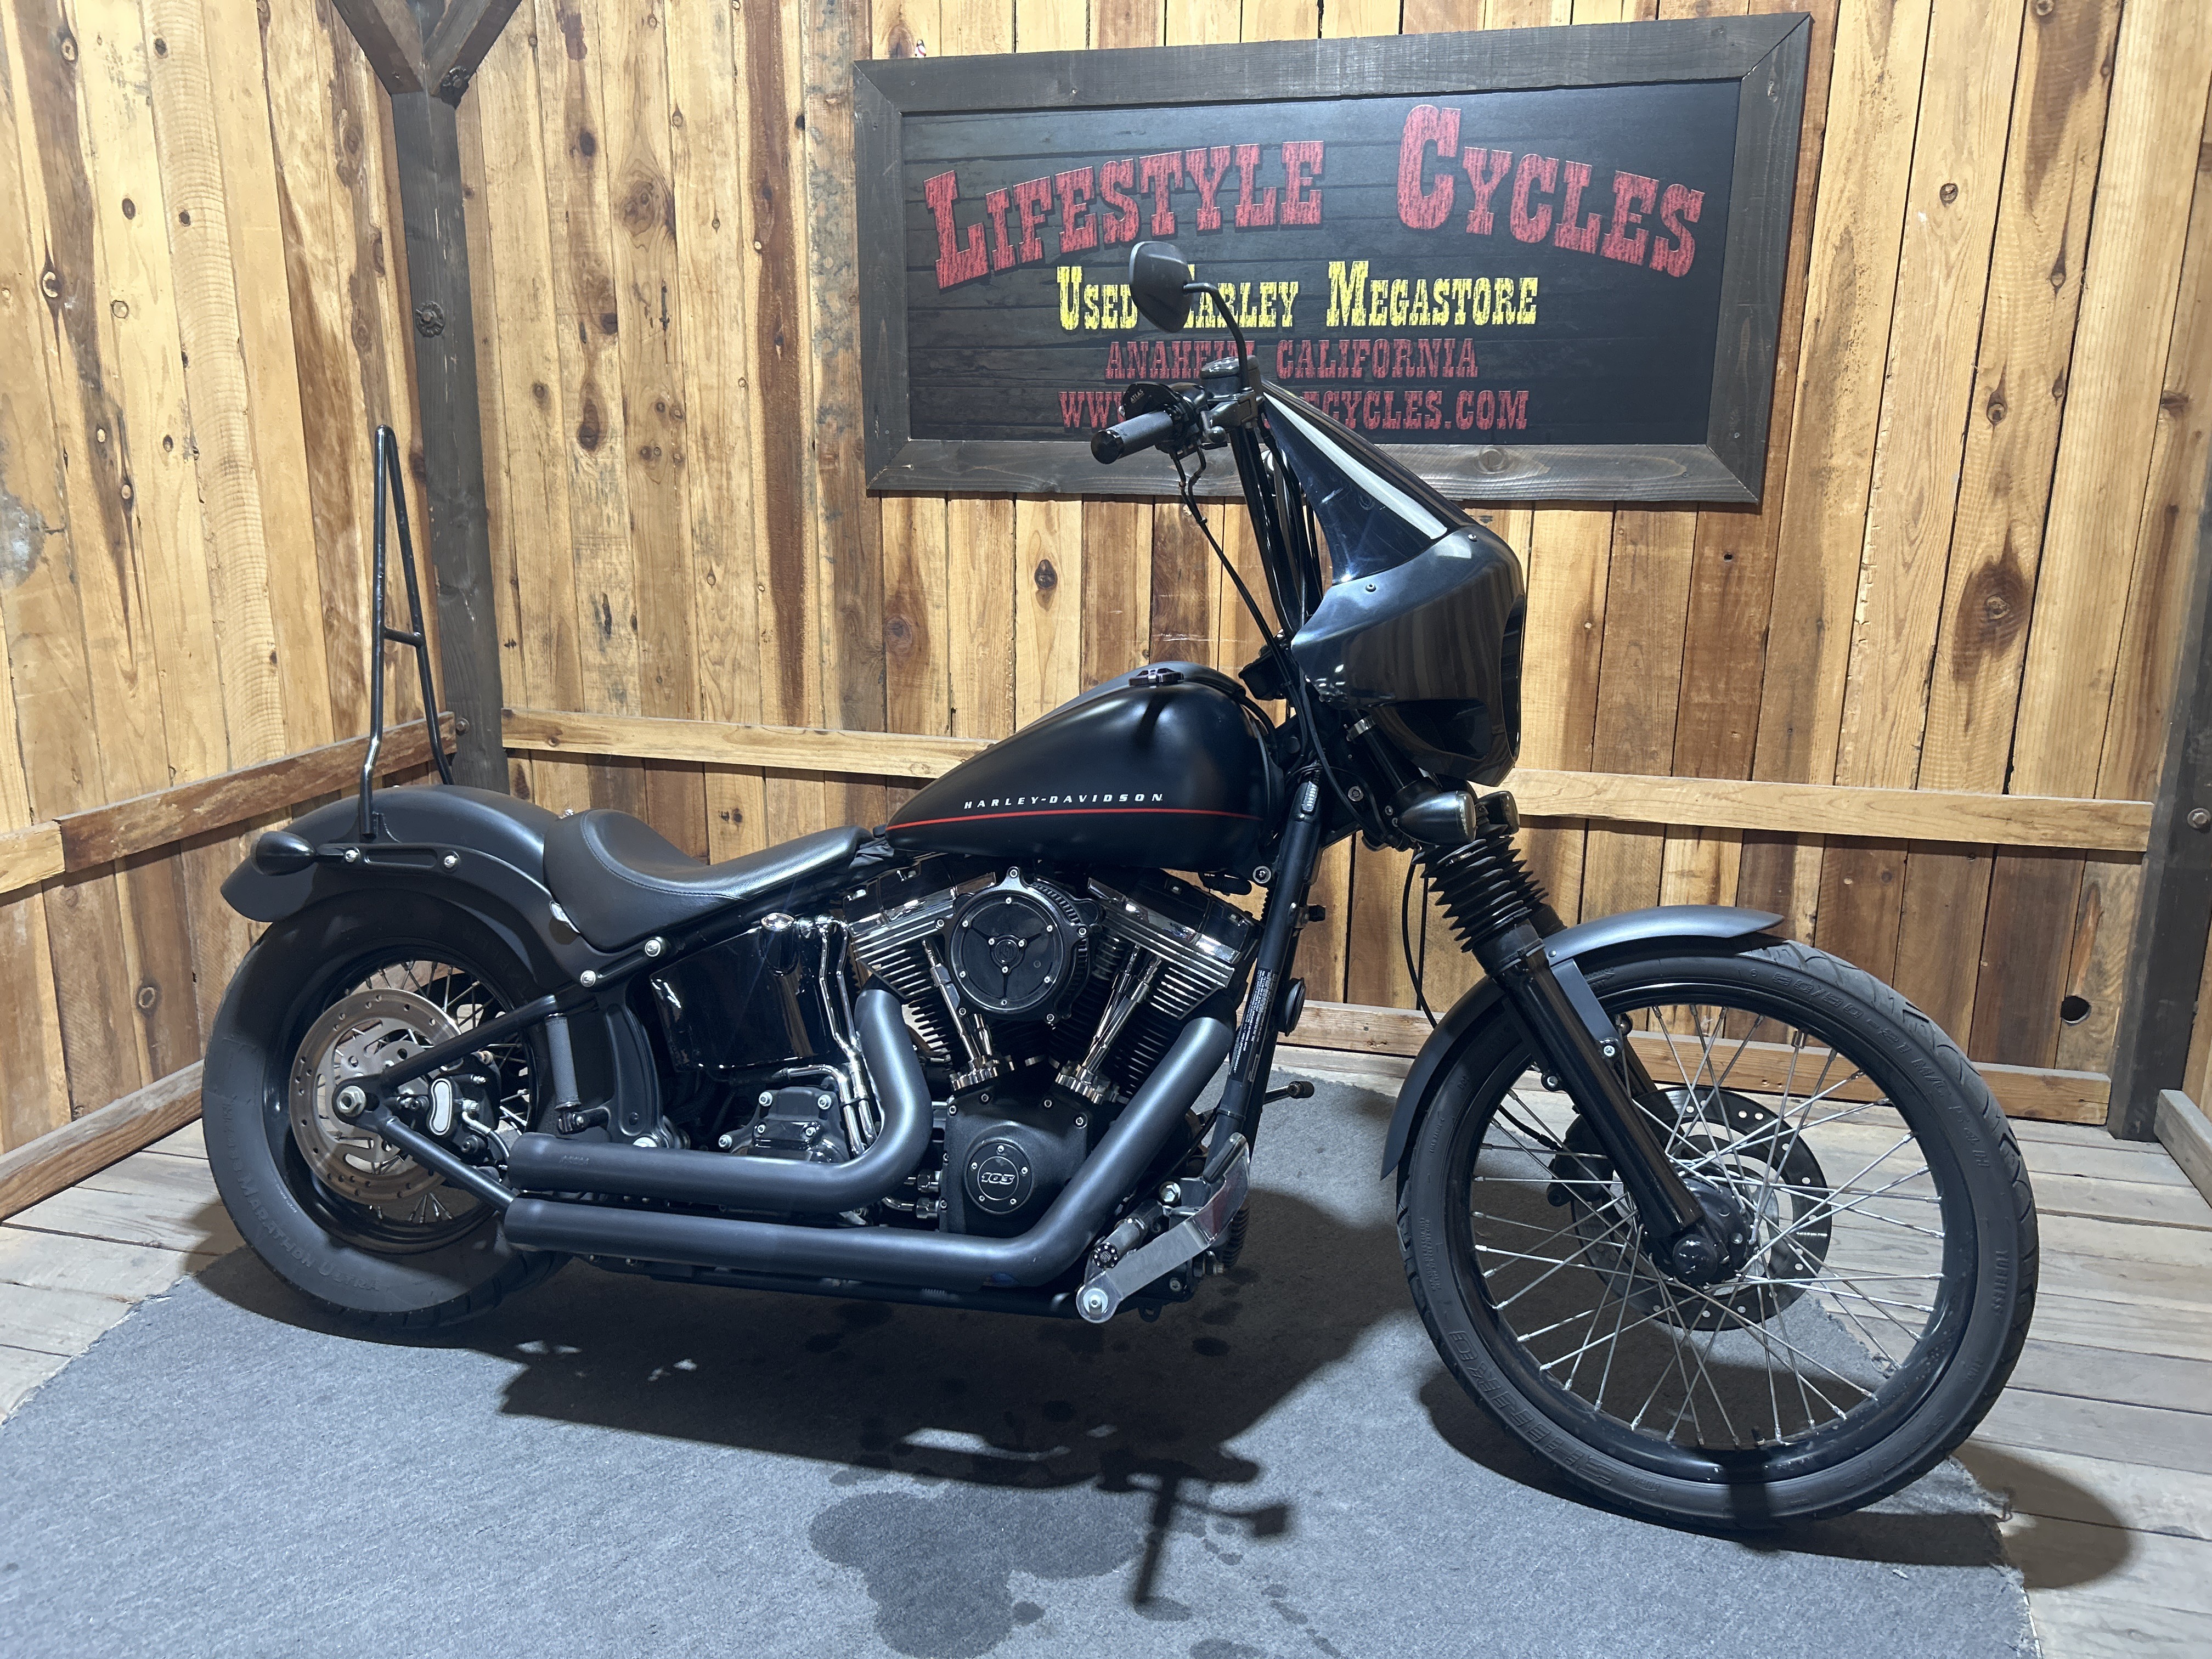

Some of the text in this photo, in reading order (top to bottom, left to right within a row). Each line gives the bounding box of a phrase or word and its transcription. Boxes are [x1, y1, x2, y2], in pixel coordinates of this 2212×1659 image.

[923, 104, 1706, 289] LIFESTYLE CYCLES
[1057, 260, 1538, 330] USED ARLEY MEGASTORE
[1276, 338, 1479, 379] CALIFORNIA
[1130, 389, 1144, 402] ATLAS
[964, 793, 1163, 809] HARLEY-DAVIDSON
[981, 1172, 1015, 1186] 103
